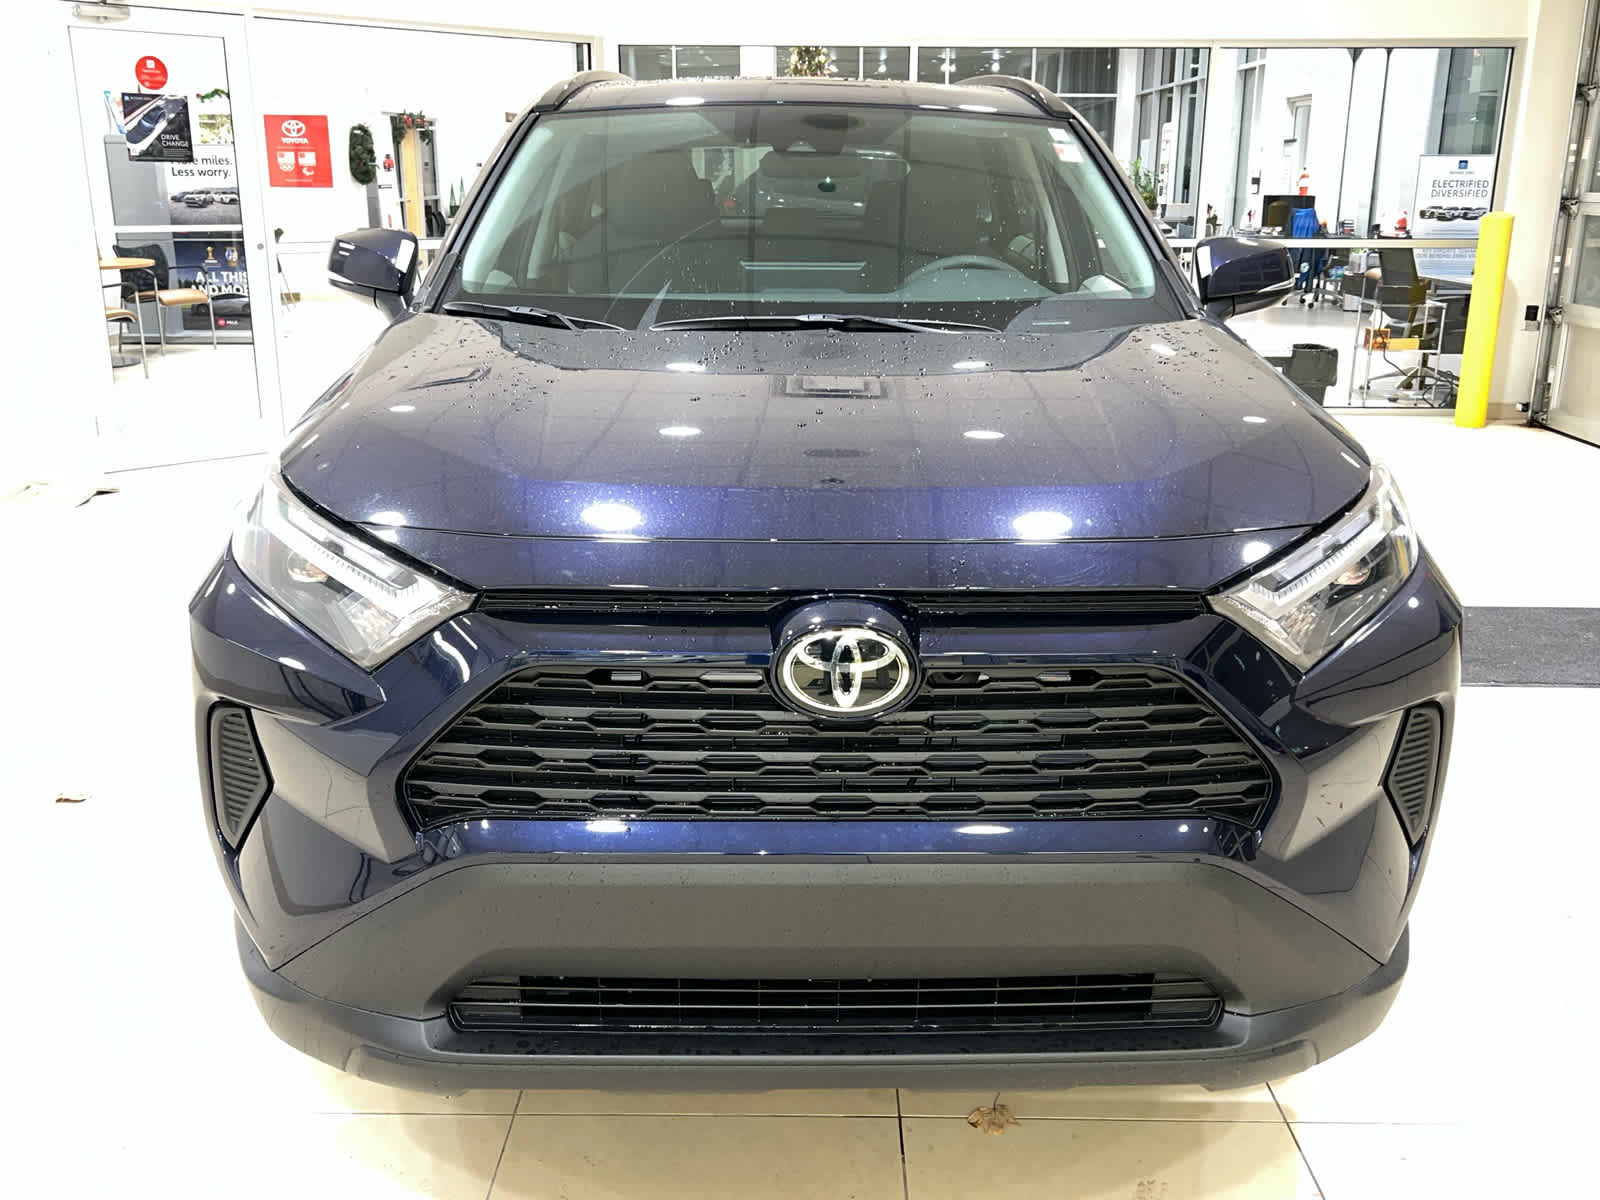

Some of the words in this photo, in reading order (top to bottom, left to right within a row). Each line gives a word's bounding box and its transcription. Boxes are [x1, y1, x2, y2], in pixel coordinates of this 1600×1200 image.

[201, 155, 232, 165] miles.
[171, 167, 195, 176] Less
[197, 169, 231, 179] worry.
[1432, 179, 1489, 188] ELECTRIFIED
[1431, 189, 1488, 198] DIVERSIFIED
